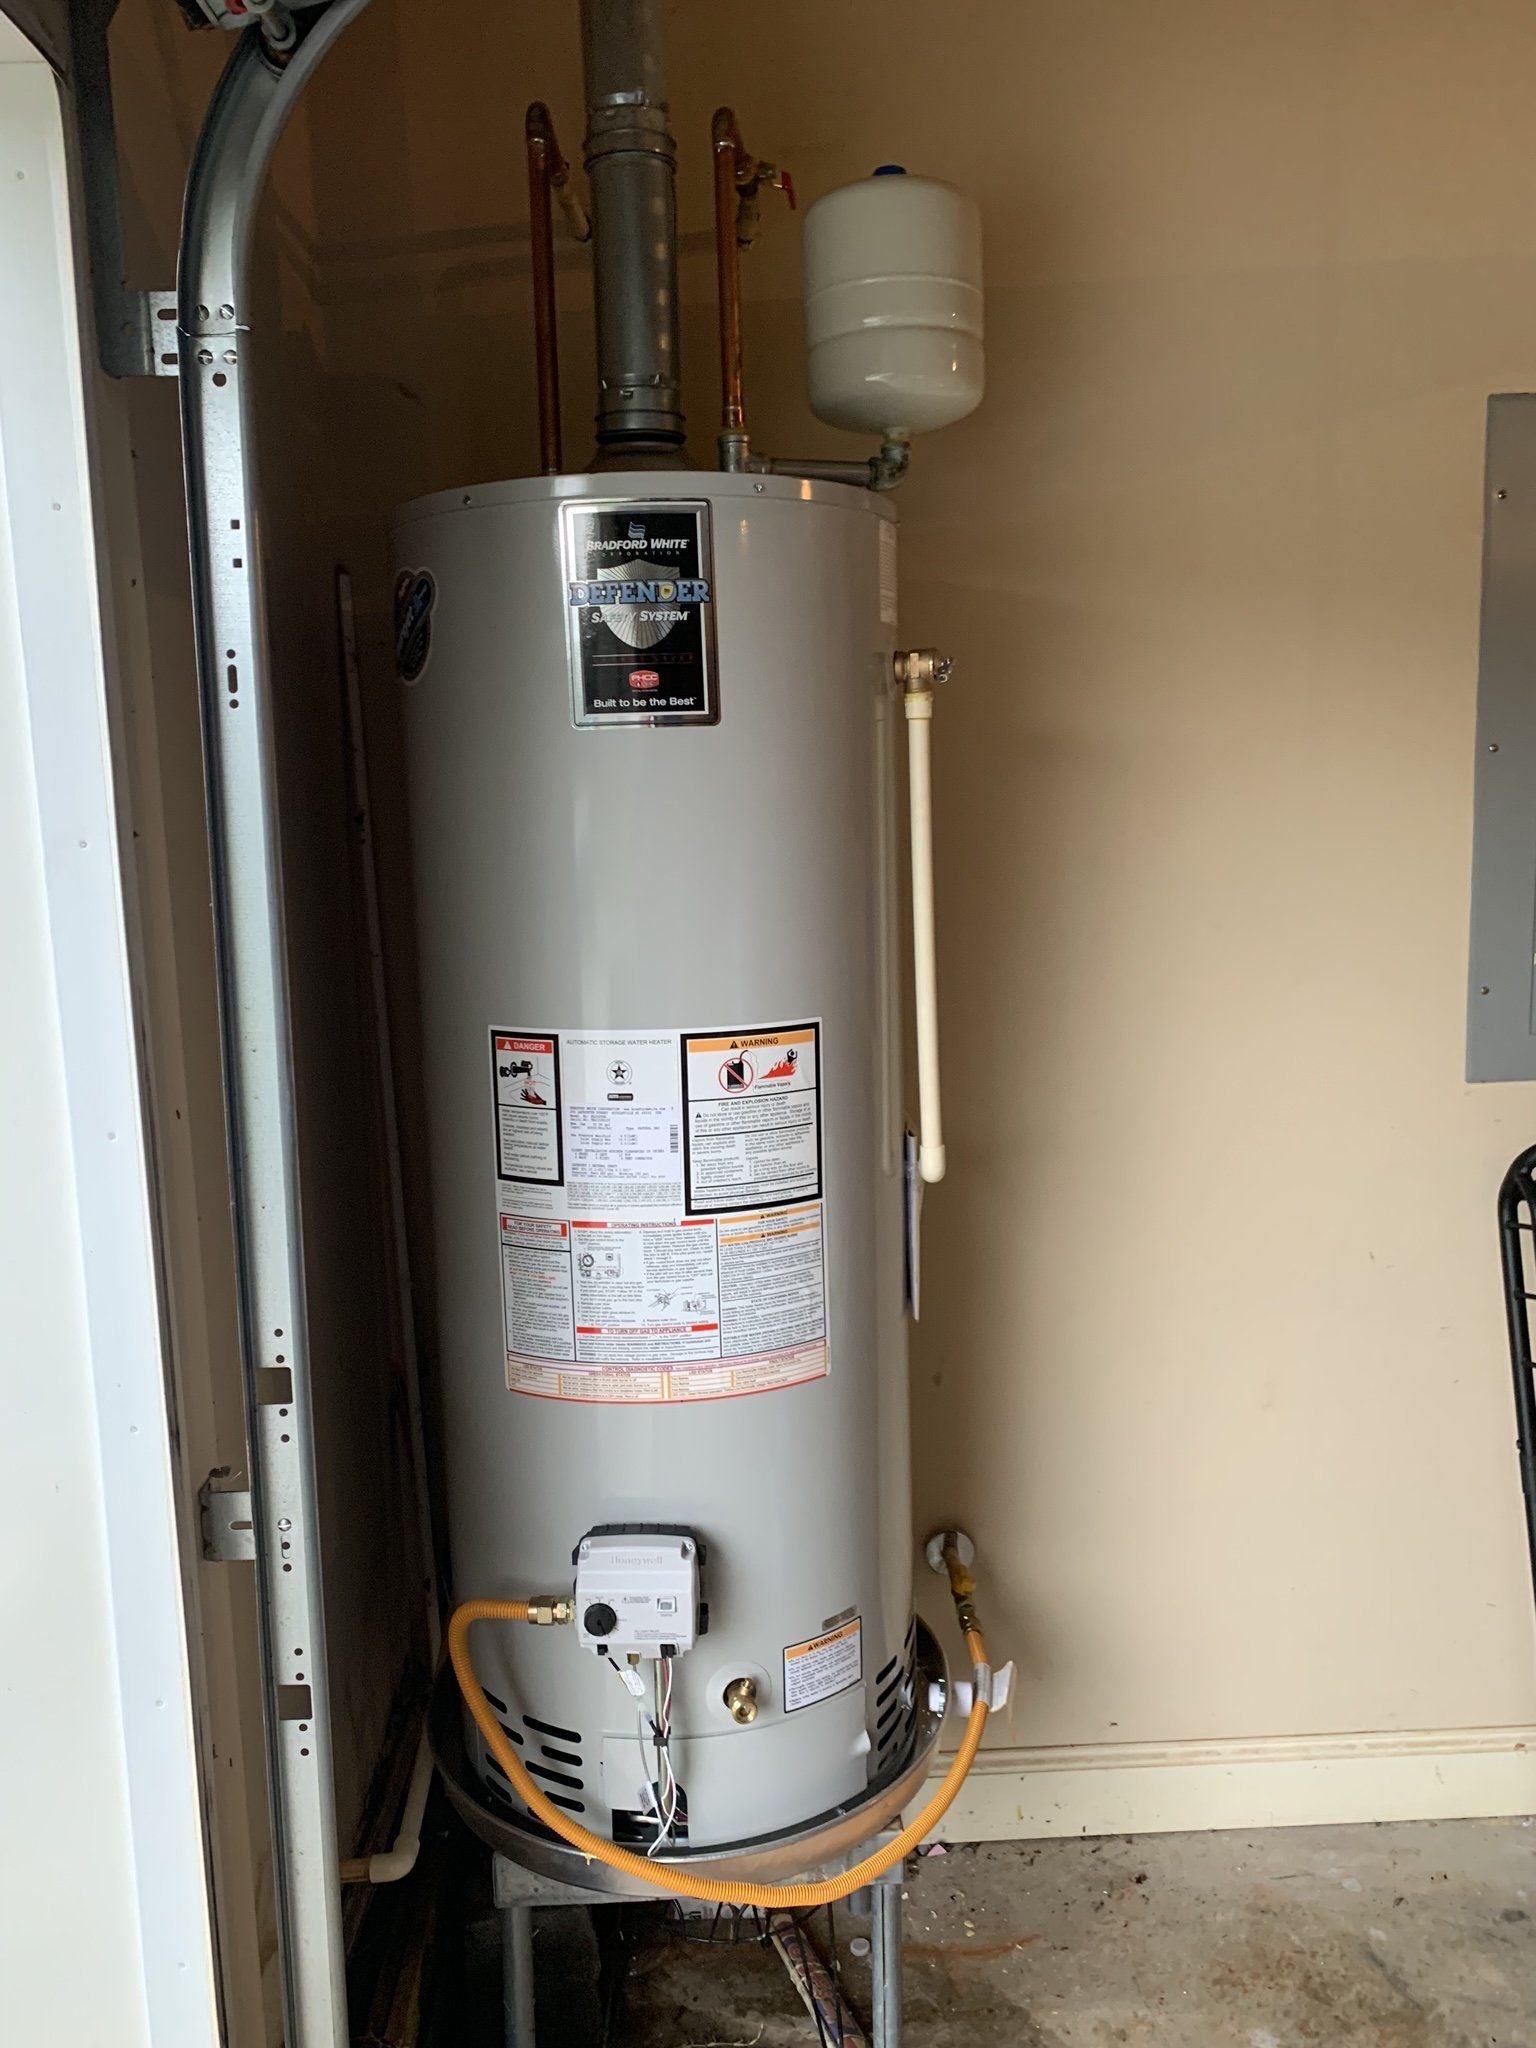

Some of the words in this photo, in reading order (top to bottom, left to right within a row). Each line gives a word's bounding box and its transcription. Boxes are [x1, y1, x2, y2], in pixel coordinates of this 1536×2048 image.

[586, 539, 648, 551] BRADFORD
[650, 538, 688, 549] WHITE
[569, 579, 711, 606] DEFENDER
[640, 610, 689, 622] SYSTEM
[594, 699, 617, 708] Built
[619, 699, 630, 707] to
[632, 698, 646, 707] be
[649, 697, 667, 707] the
[669, 697, 694, 706] Best
[514, 1042, 546, 1051] DANGER
[566, 1038, 598, 1046] AUTOMATIC
[741, 1037, 778, 1048] WARNING
[814, 1631, 843, 1649] WARNING
